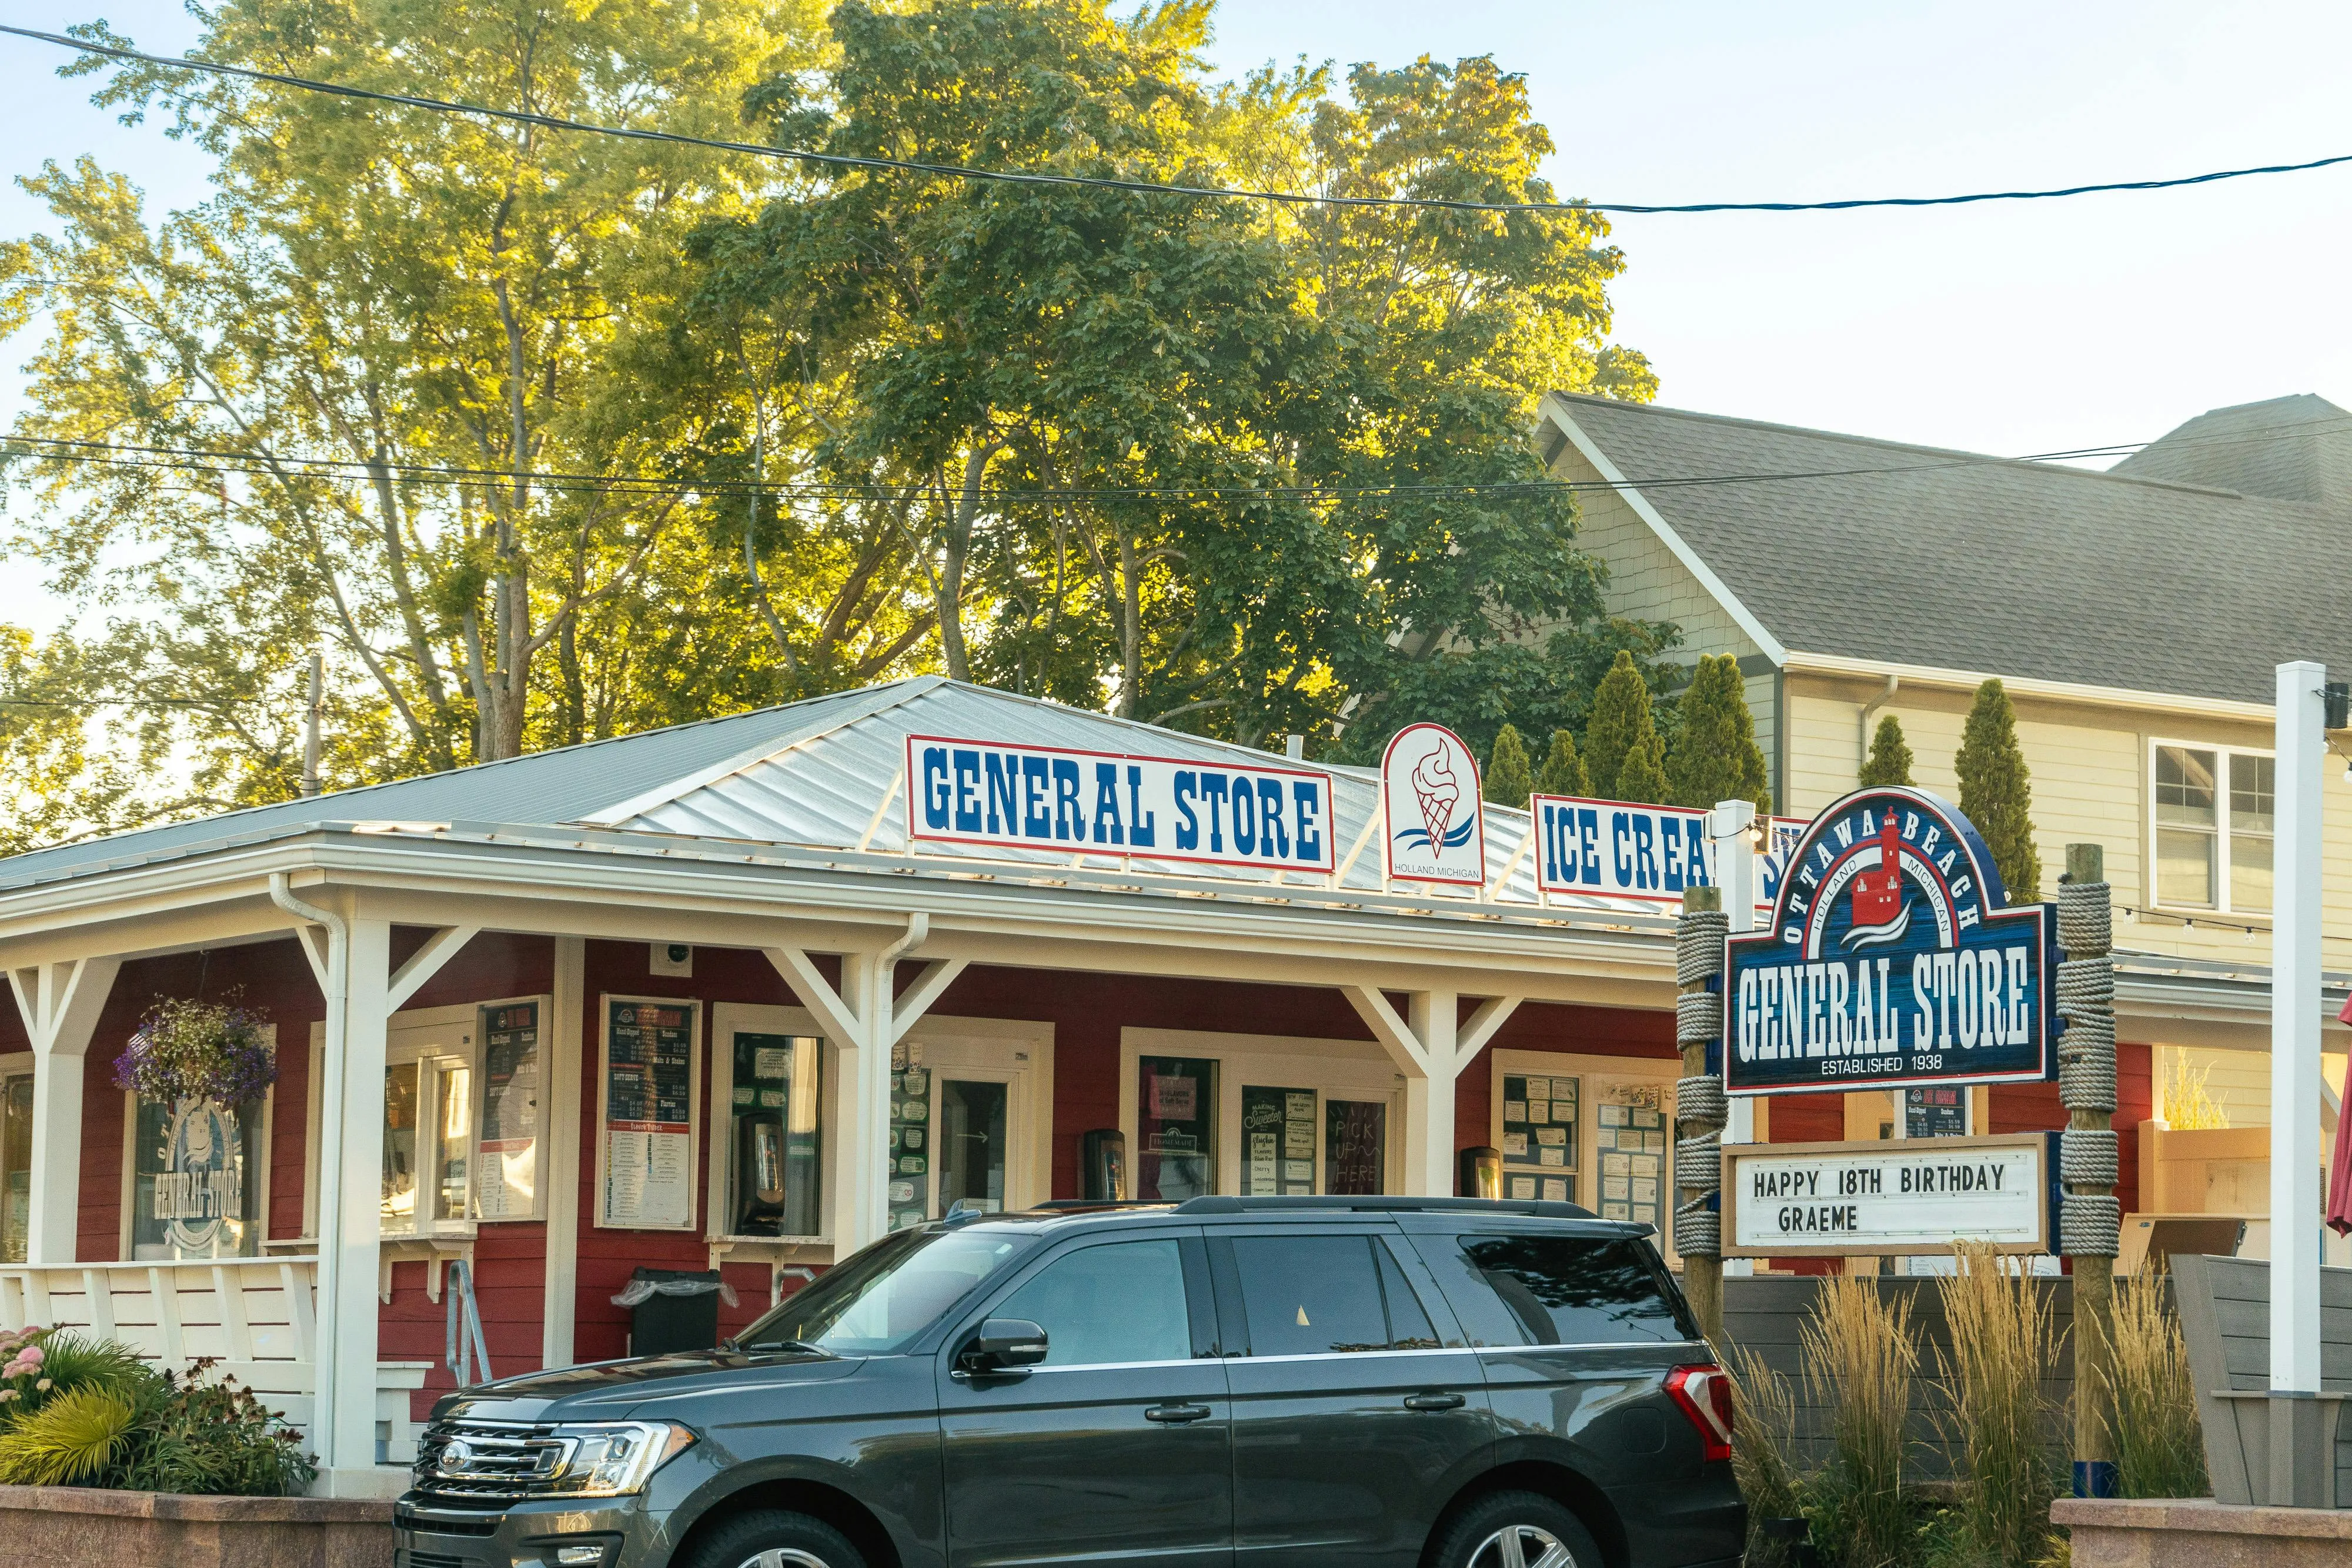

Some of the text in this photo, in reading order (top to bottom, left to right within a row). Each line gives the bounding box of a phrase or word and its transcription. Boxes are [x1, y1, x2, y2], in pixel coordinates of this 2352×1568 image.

[923, 747, 1321, 861] GENERAL STORE
[1545, 805, 1601, 886] ICE
[1612, 811, 1716, 891] CREA
[1395, 864, 1479, 878] HOLLAND MICHIGAN
[1784, 810, 1979, 944] OTTAWA BEACH
[1814, 859, 1948, 931] HOLLAND MICHIGAN
[1739, 946, 2029, 1063] GENERAL STORE
[1822, 1054, 1942, 1075] ESTABLISHED 1938
[1244, 1110, 1282, 1129] Sweeter
[1336, 1121, 1374, 1139] PICK
[1336, 1142, 1356, 1159] UP
[1336, 1165, 1376, 1183] HERE
[1754, 1164, 2004, 1198] HAPPY 18TH BIRTHDAY
[1778, 1205, 1857, 1232] GRAEME
